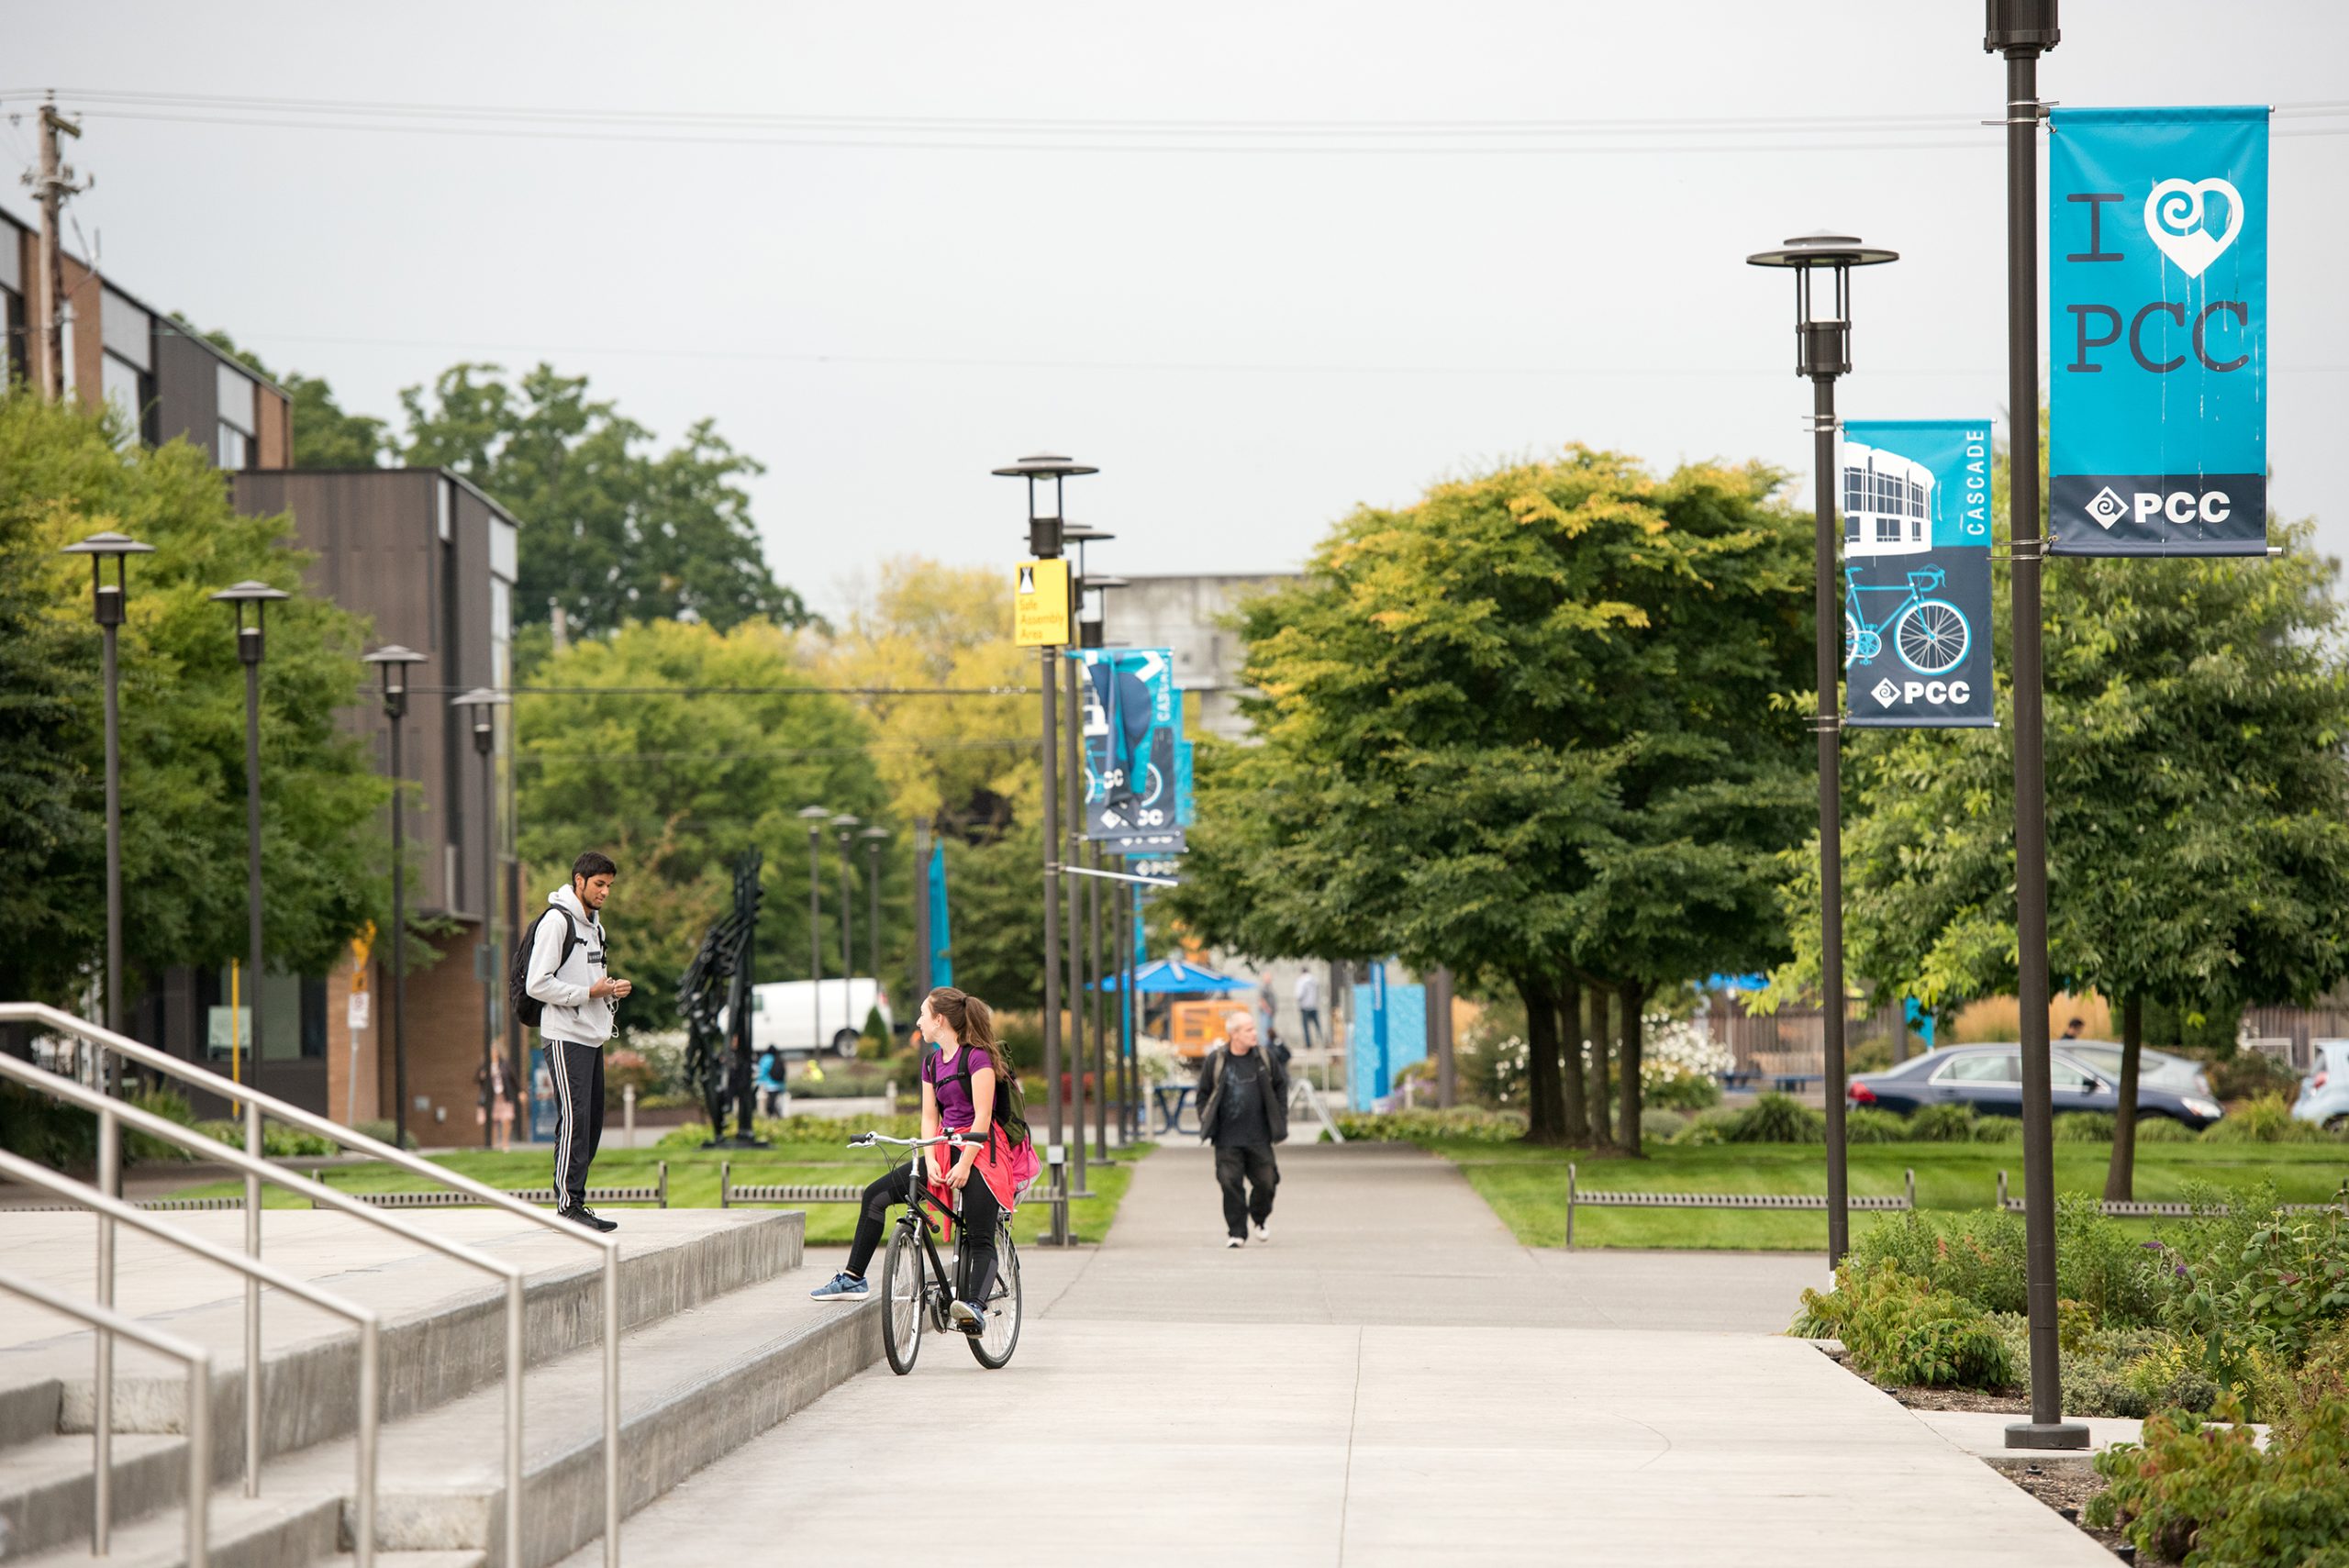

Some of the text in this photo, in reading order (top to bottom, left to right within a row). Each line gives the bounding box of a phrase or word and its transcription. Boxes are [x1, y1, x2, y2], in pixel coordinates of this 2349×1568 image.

[2066, 193, 2125, 262] I
[2066, 300, 2250, 373] PCC
[1966, 430, 1985, 536] CASCADE
[2133, 490, 2231, 523] PCC
[1019, 611, 1064, 628] Assembly
[1904, 681, 1971, 705] PCC
